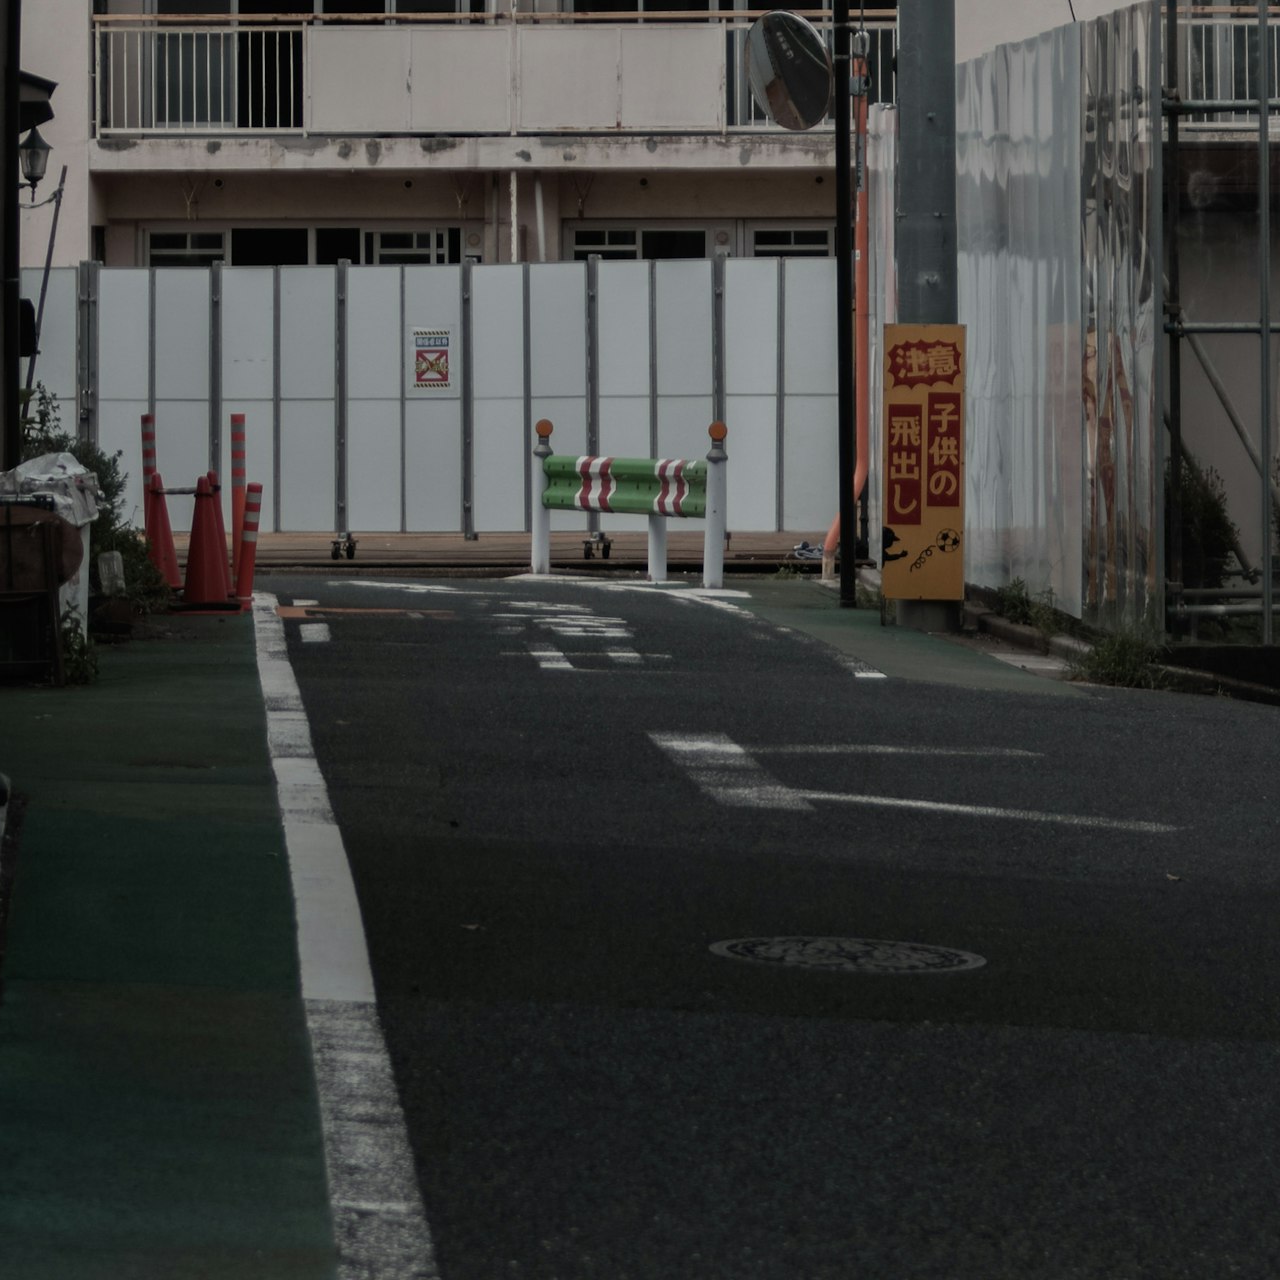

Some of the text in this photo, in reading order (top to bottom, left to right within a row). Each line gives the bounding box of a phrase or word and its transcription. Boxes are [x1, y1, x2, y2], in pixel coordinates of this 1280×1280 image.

[896, 346, 958, 378] 注意
[890, 415, 922, 515] 飛出し
[929, 402, 959, 497] 子供の
